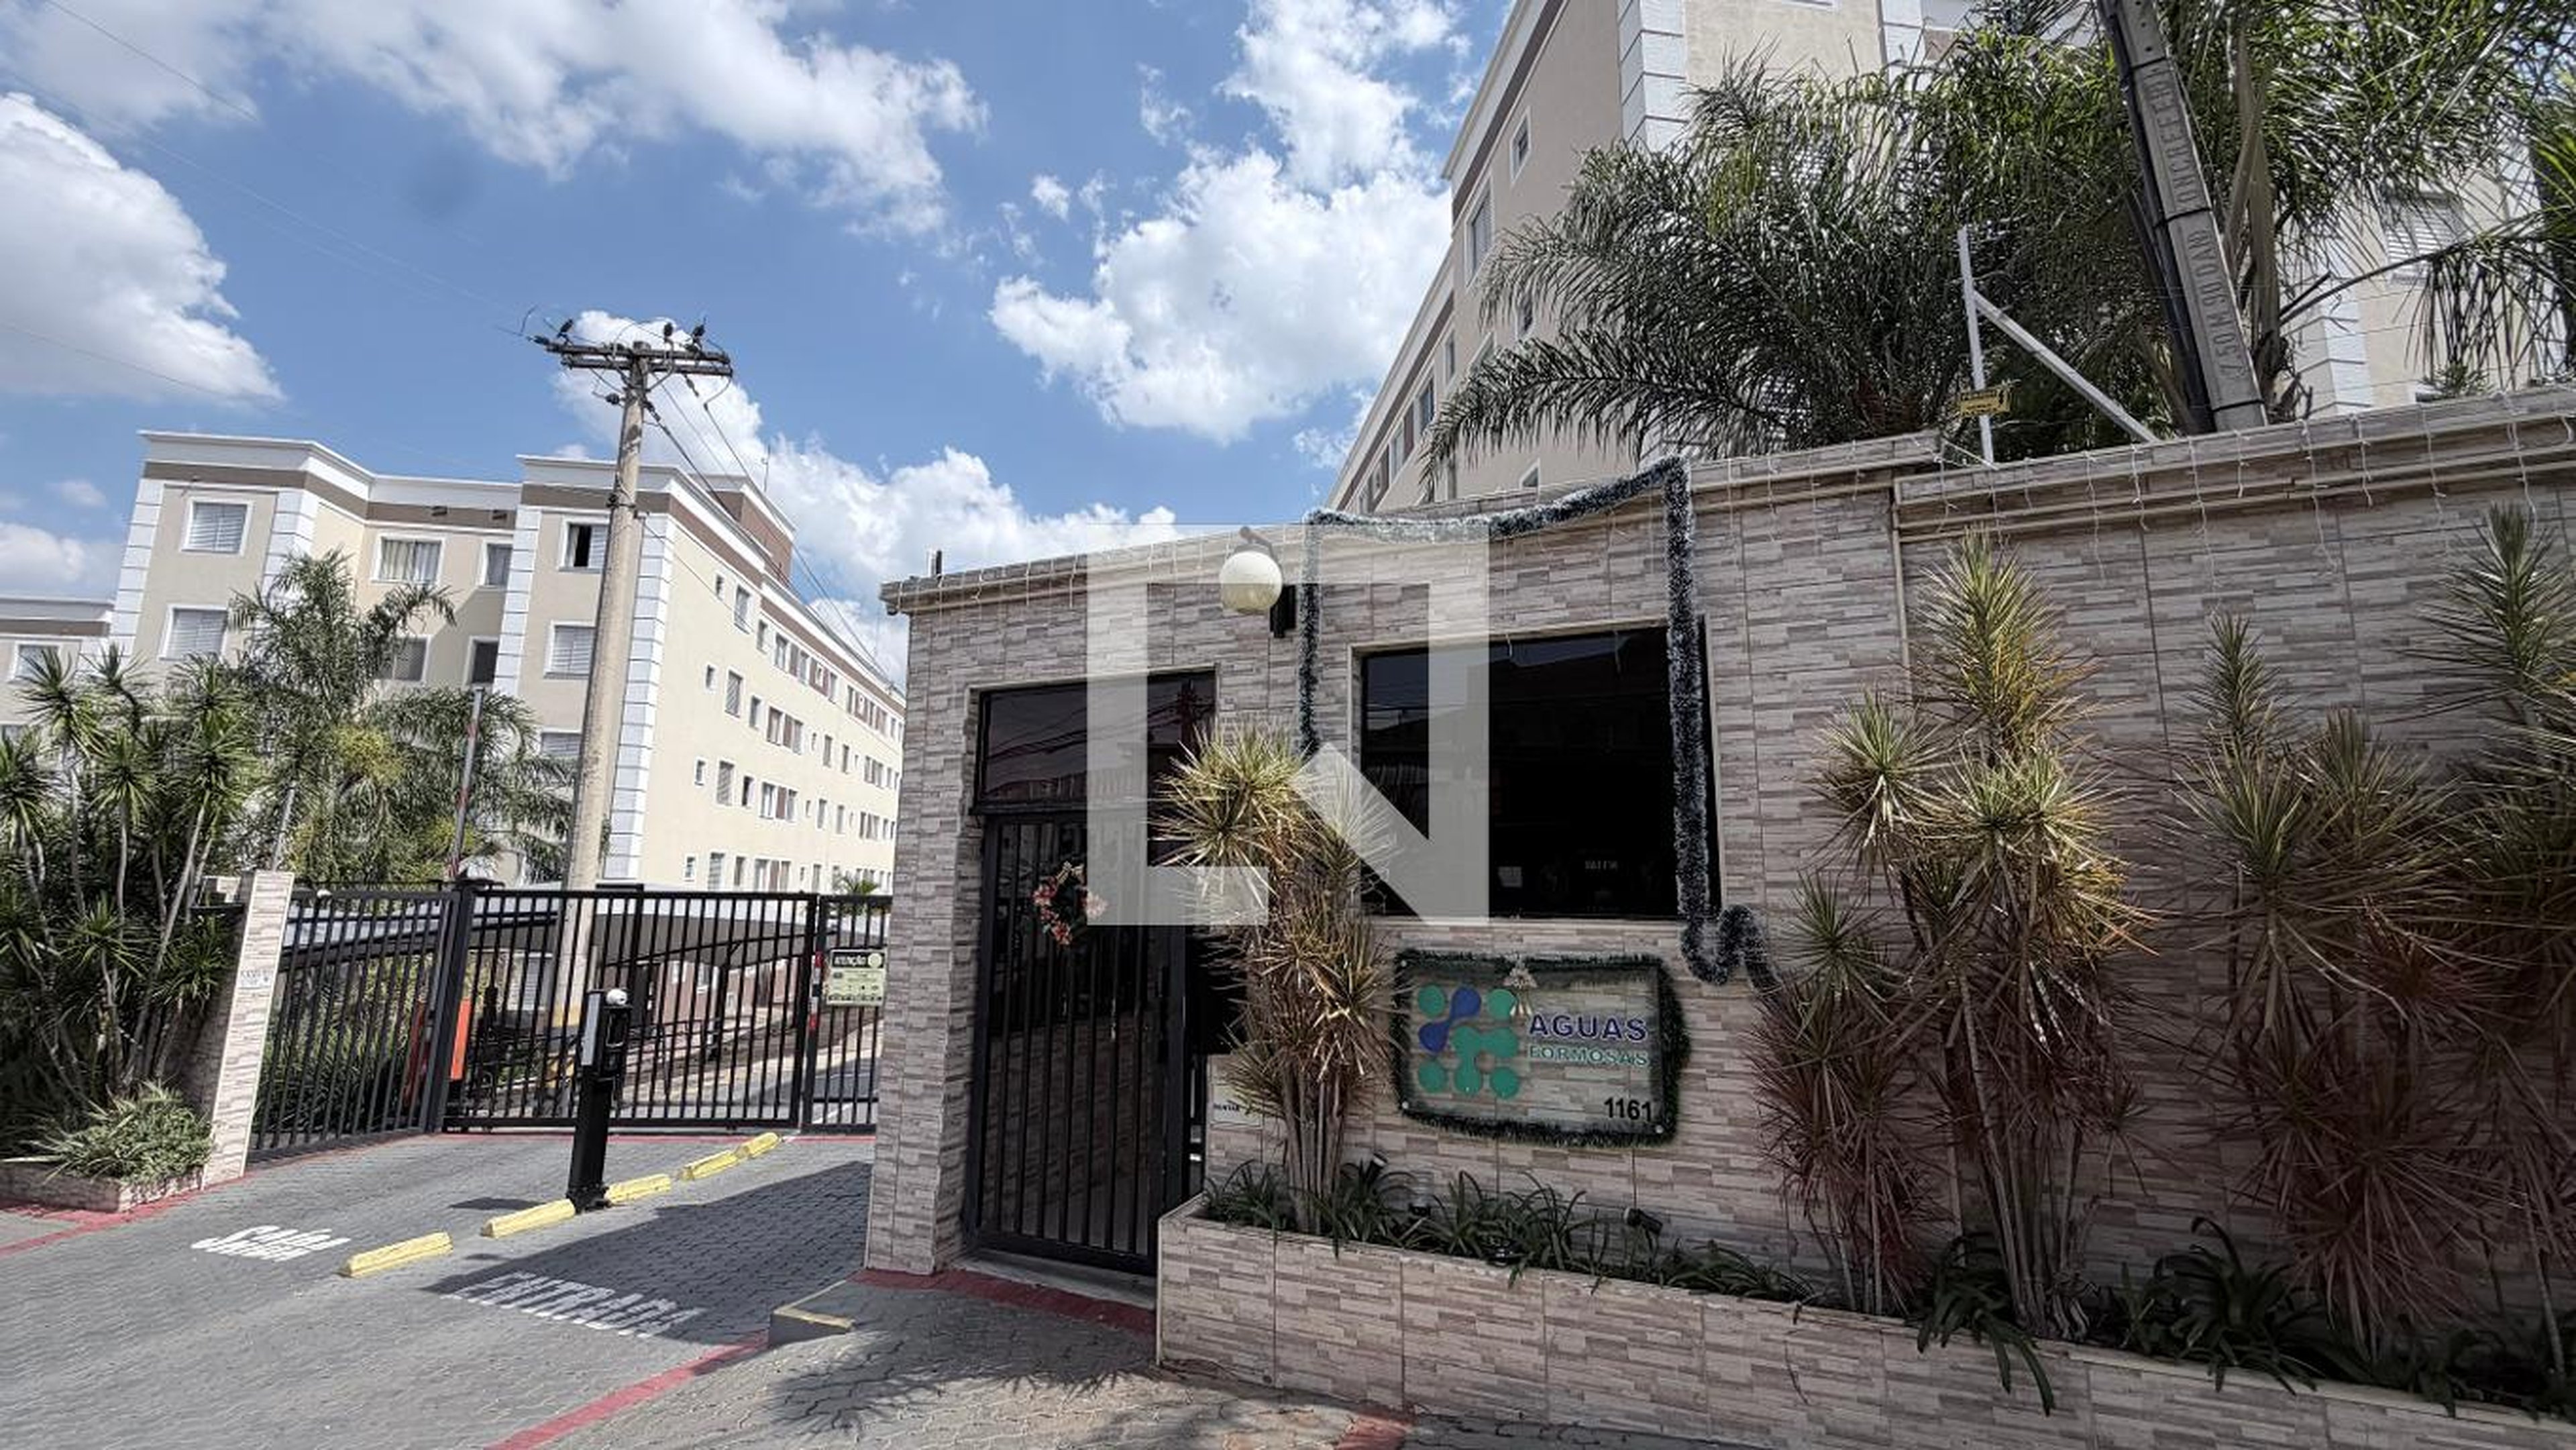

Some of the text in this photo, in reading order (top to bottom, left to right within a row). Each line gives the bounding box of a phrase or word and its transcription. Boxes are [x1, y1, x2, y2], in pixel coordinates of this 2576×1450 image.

[1528, 1014, 1648, 1041] AGUAS
[1528, 1045, 1649, 1066] FORMOSAS
[1604, 1097, 1652, 1122] 1161
[439, 1272, 708, 1338] ENTRADA
